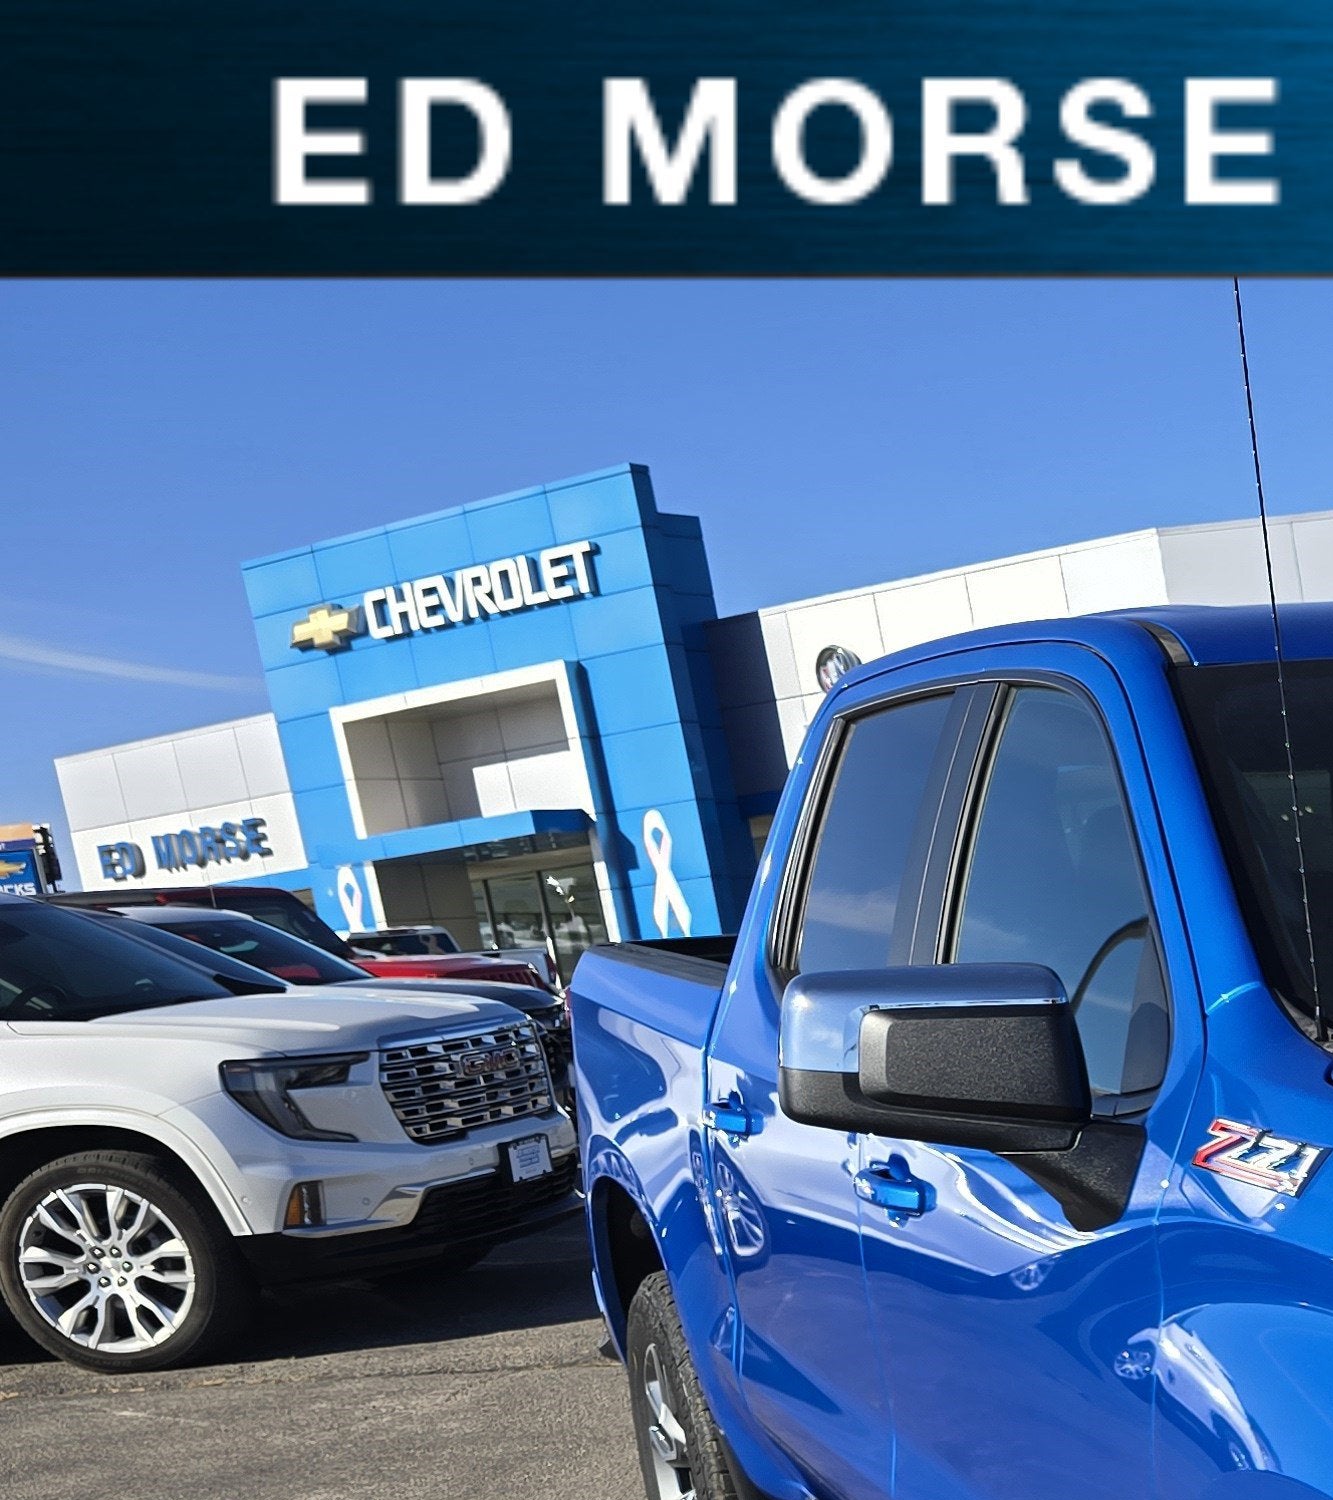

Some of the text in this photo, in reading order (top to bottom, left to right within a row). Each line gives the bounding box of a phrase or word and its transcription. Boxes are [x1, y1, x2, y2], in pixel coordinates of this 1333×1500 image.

[363, 540, 597, 640] CHEVROLET
[97, 818, 272, 881] ED MORSE
[462, 1049, 520, 1076] GMC
[1192, 1117, 1333, 1199] Z71
